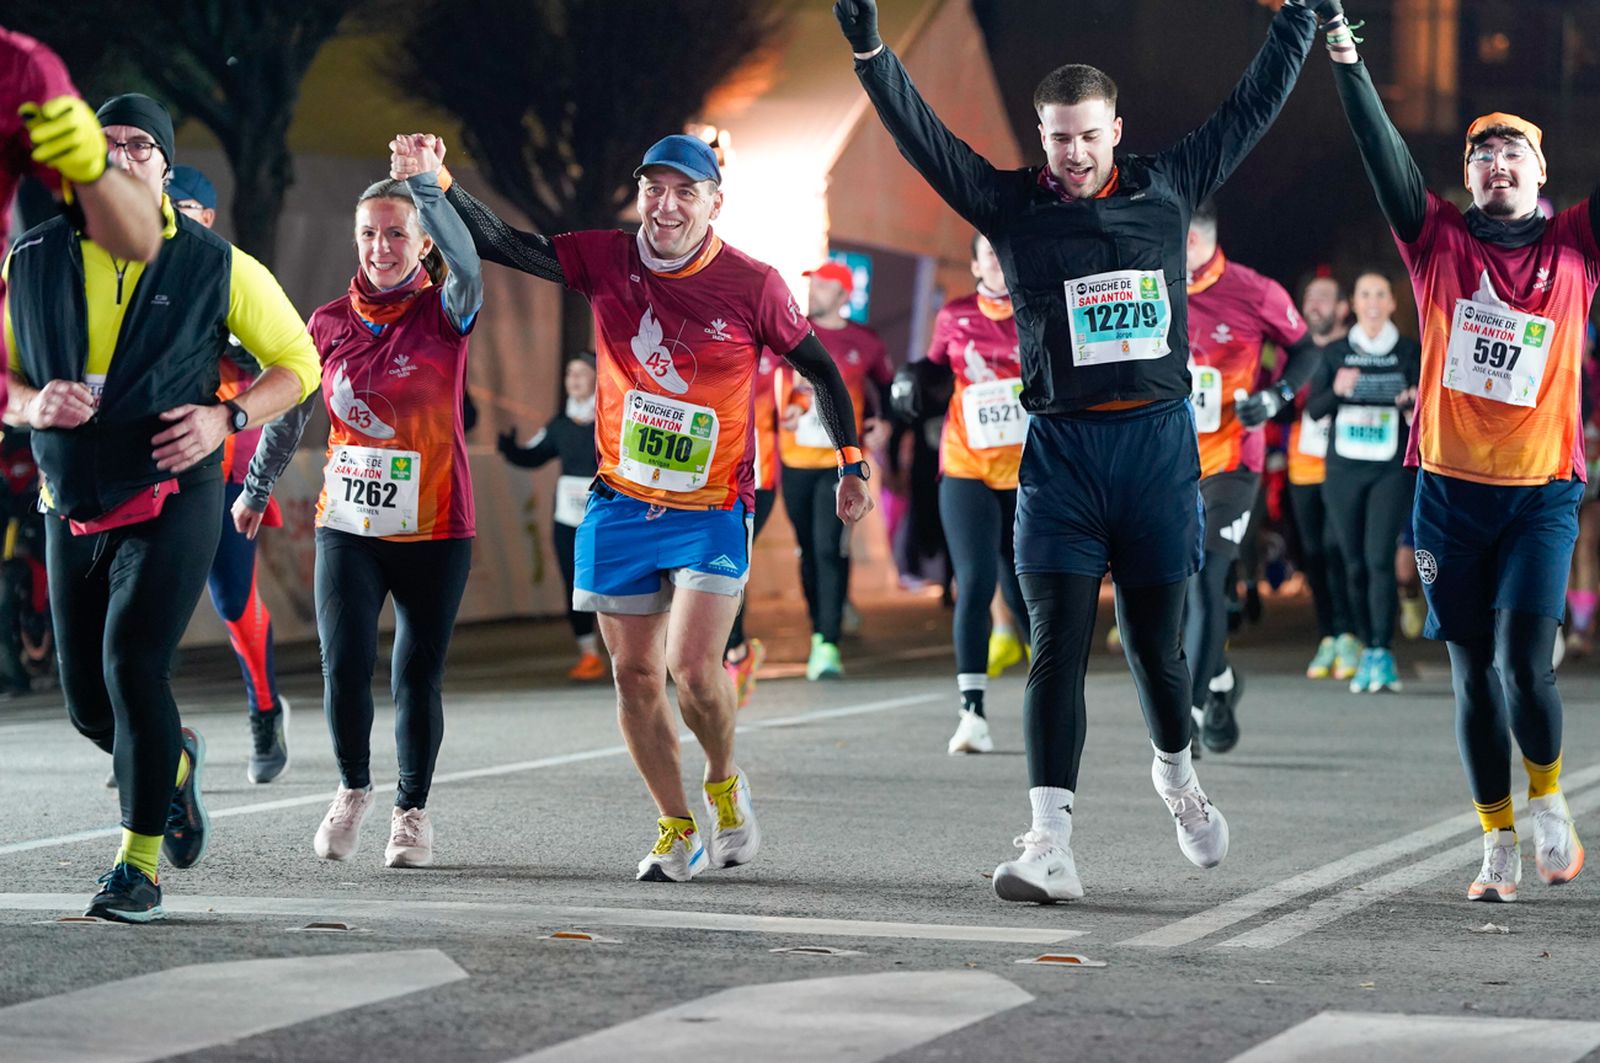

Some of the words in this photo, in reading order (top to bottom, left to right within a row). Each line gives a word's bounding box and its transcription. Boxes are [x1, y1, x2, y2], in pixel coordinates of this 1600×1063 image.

[1078, 295, 1099, 307] SAN
[1100, 288, 1133, 303] ANTÓN
[1088, 281, 1119, 294] NOCHE
[1120, 280, 1132, 290] DE
[1083, 302, 1158, 333] 12279
[1474, 313, 1505, 327] NOCHE
[1504, 320, 1517, 331] DE
[1462, 321, 1481, 334] SAN
[1481, 327, 1516, 342] ANTÓN
[645, 351, 671, 377] 43
[1473, 337, 1522, 372] 597
[1487, 369, 1512, 381] CARLOS
[347, 406, 372, 429] 43
[632, 411, 648, 423] SAN
[649, 417, 683, 433] ANTÓN
[642, 403, 672, 418] NOCHE
[672, 410, 685, 421] DE
[978, 404, 1021, 425] 6521
[638, 426, 694, 463] 1510
[335, 465, 352, 475] SAN
[371, 458, 383, 468] DE
[342, 477, 398, 508] 7262
